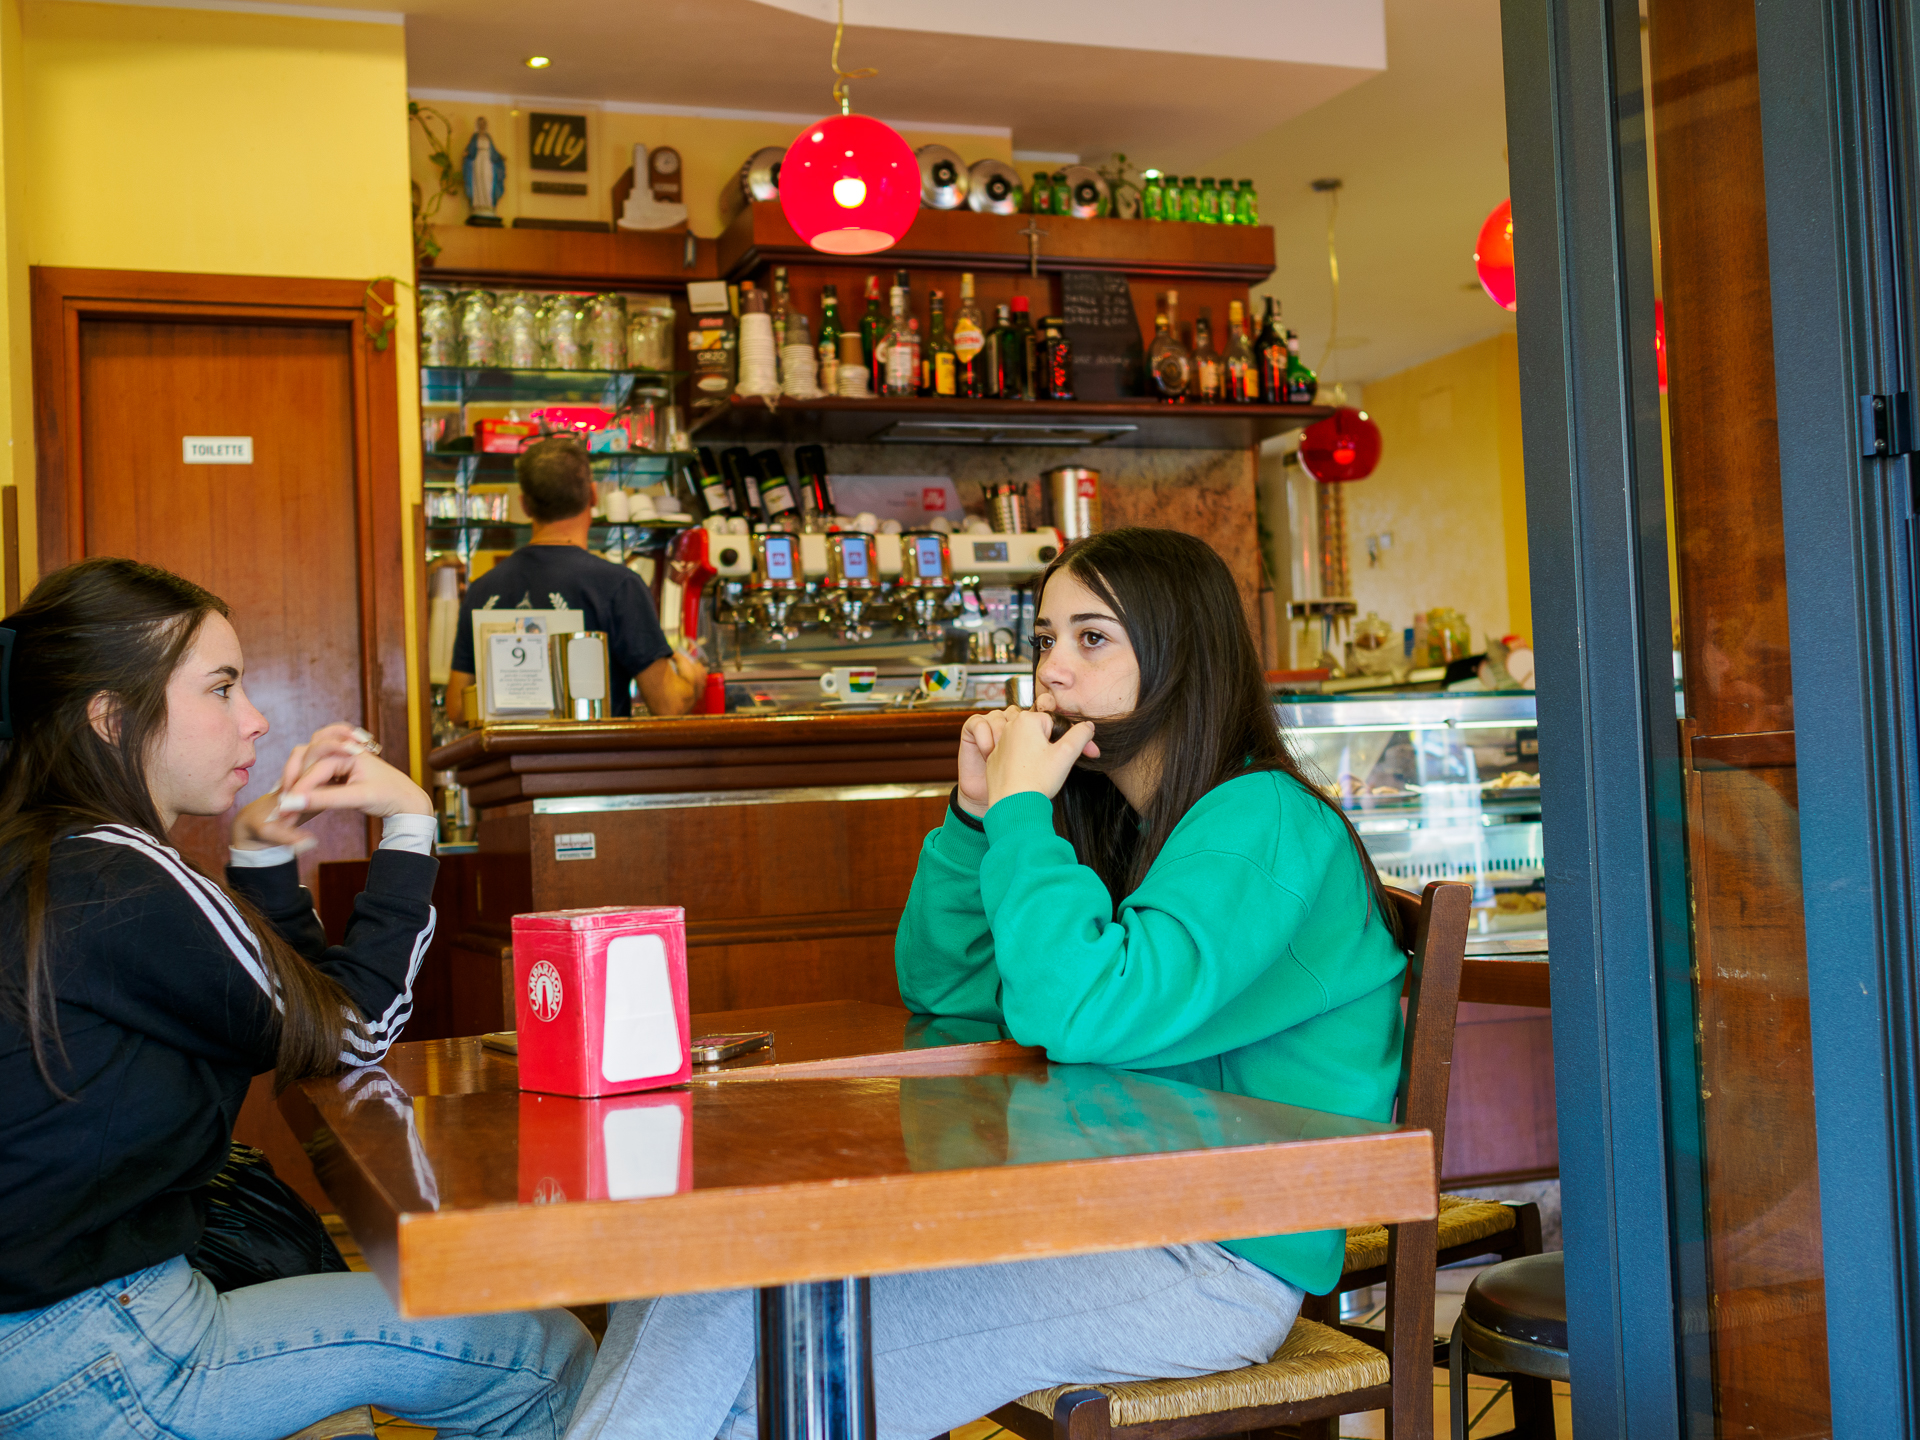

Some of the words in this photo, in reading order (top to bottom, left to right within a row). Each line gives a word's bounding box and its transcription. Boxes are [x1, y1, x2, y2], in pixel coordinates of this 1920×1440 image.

[533, 121, 584, 167] illy
[192, 444, 244, 456] TOILETTE
[511, 647, 526, 667] 9
